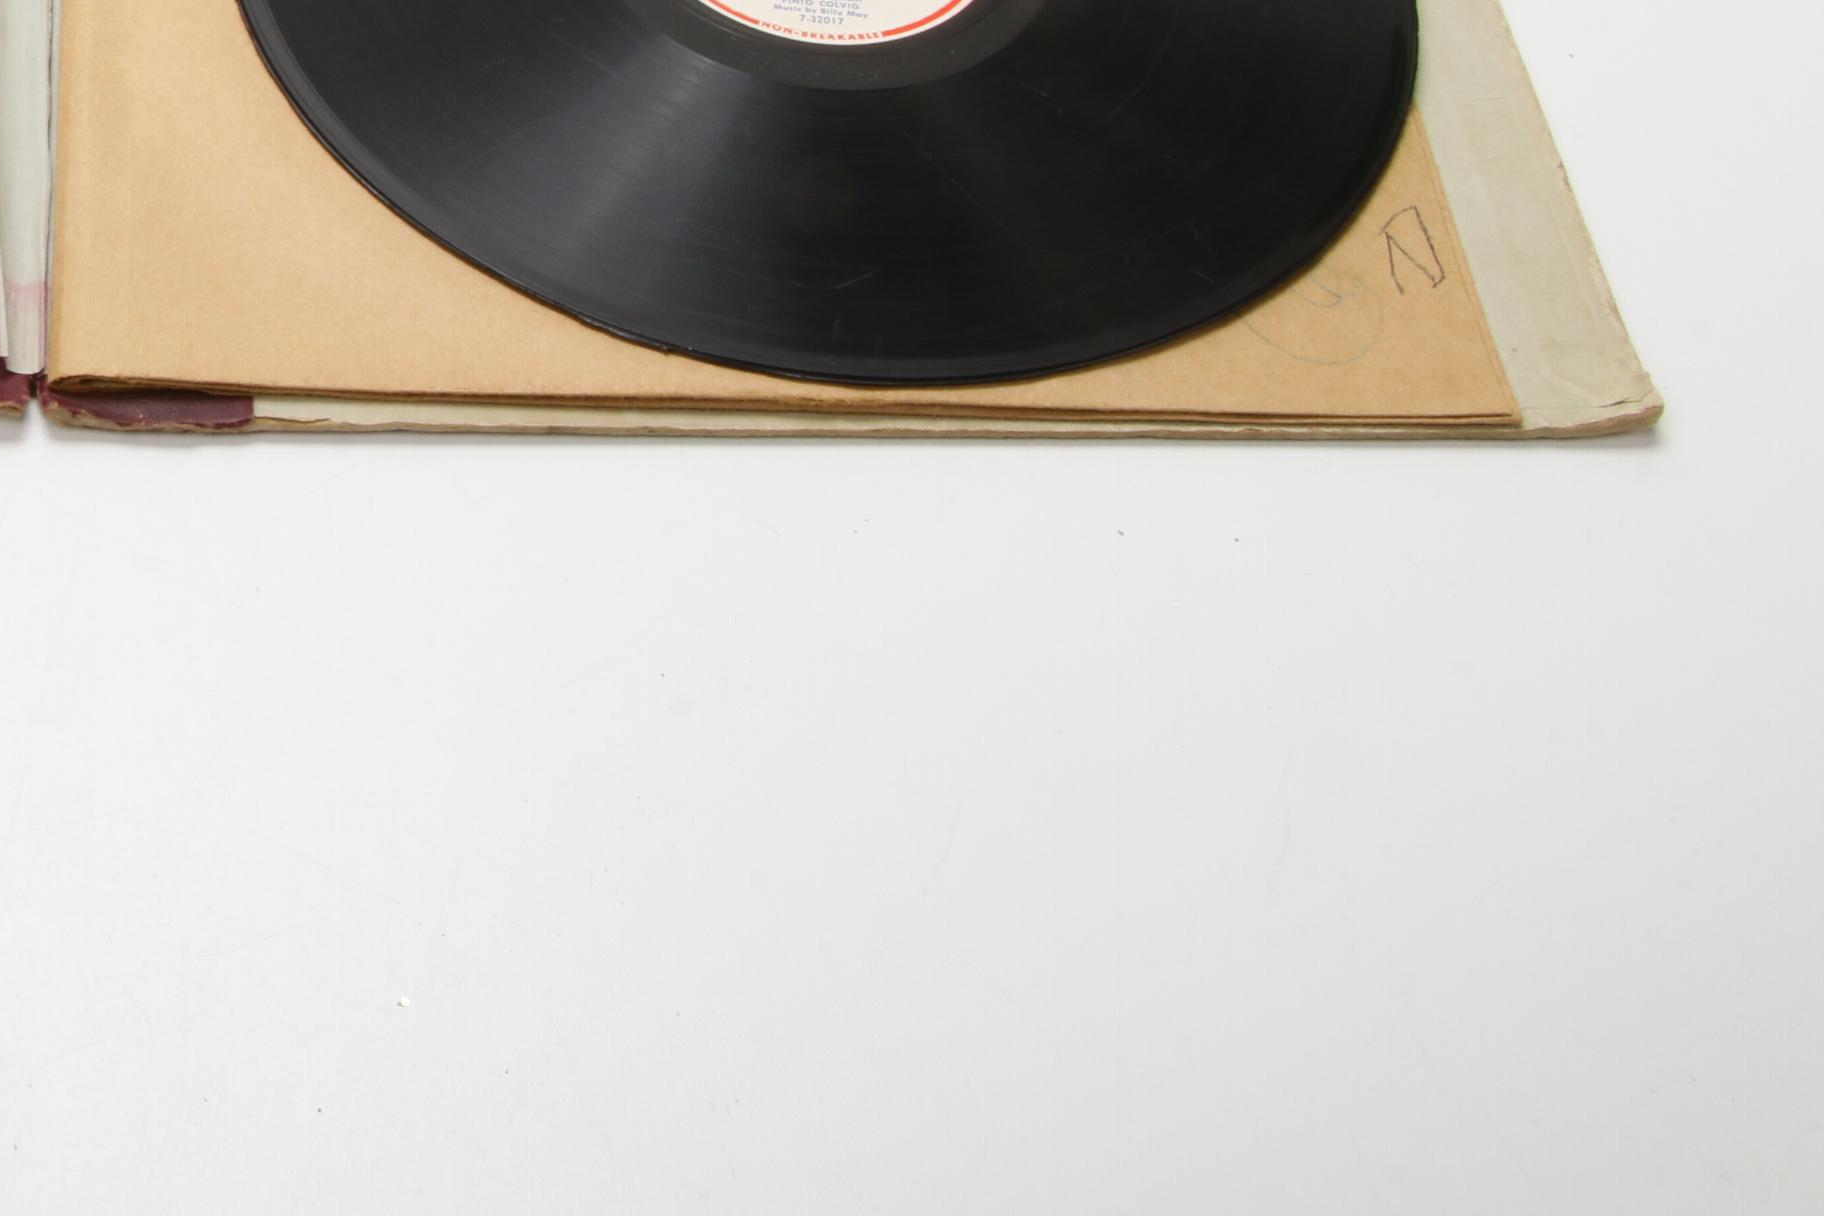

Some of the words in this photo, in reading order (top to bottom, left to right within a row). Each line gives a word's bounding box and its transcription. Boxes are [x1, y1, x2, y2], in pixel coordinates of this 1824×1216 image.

[773, 3, 803, 14] Music
[805, 5, 818, 15] by
[819, 6, 844, 18] Billy
[846, 10, 869, 20] May
[818, 0, 861, 11] COLVIG
[800, 13, 845, 26] 7-32017
[761, 21, 883, 41] NON-BREAKABLE
